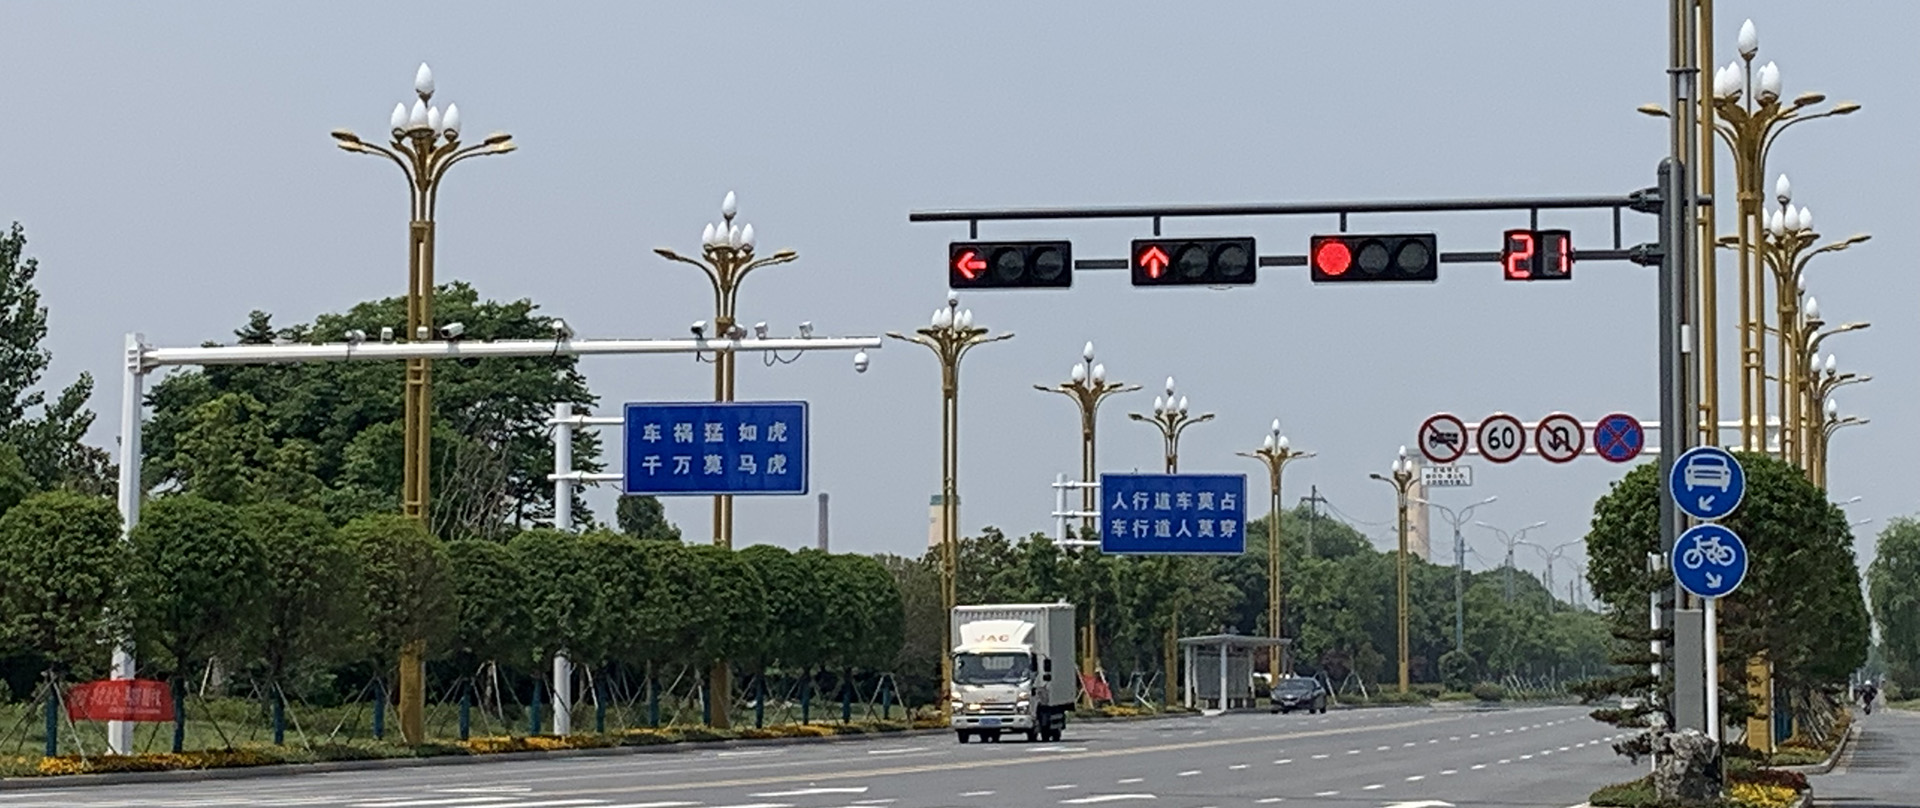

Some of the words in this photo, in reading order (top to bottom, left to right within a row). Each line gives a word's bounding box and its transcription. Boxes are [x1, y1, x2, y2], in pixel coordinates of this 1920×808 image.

[1508, 234, 1567, 277] 21
[642, 421, 788, 443] 车祸猛如虎
[1488, 427, 1514, 449] 60
[642, 454, 788, 476] 千万莫马虎
[1111, 491, 1237, 511] 人行道车莫占
[1111, 519, 1237, 539] 车行道人莫穿
[974, 634, 1010, 643] JAC
